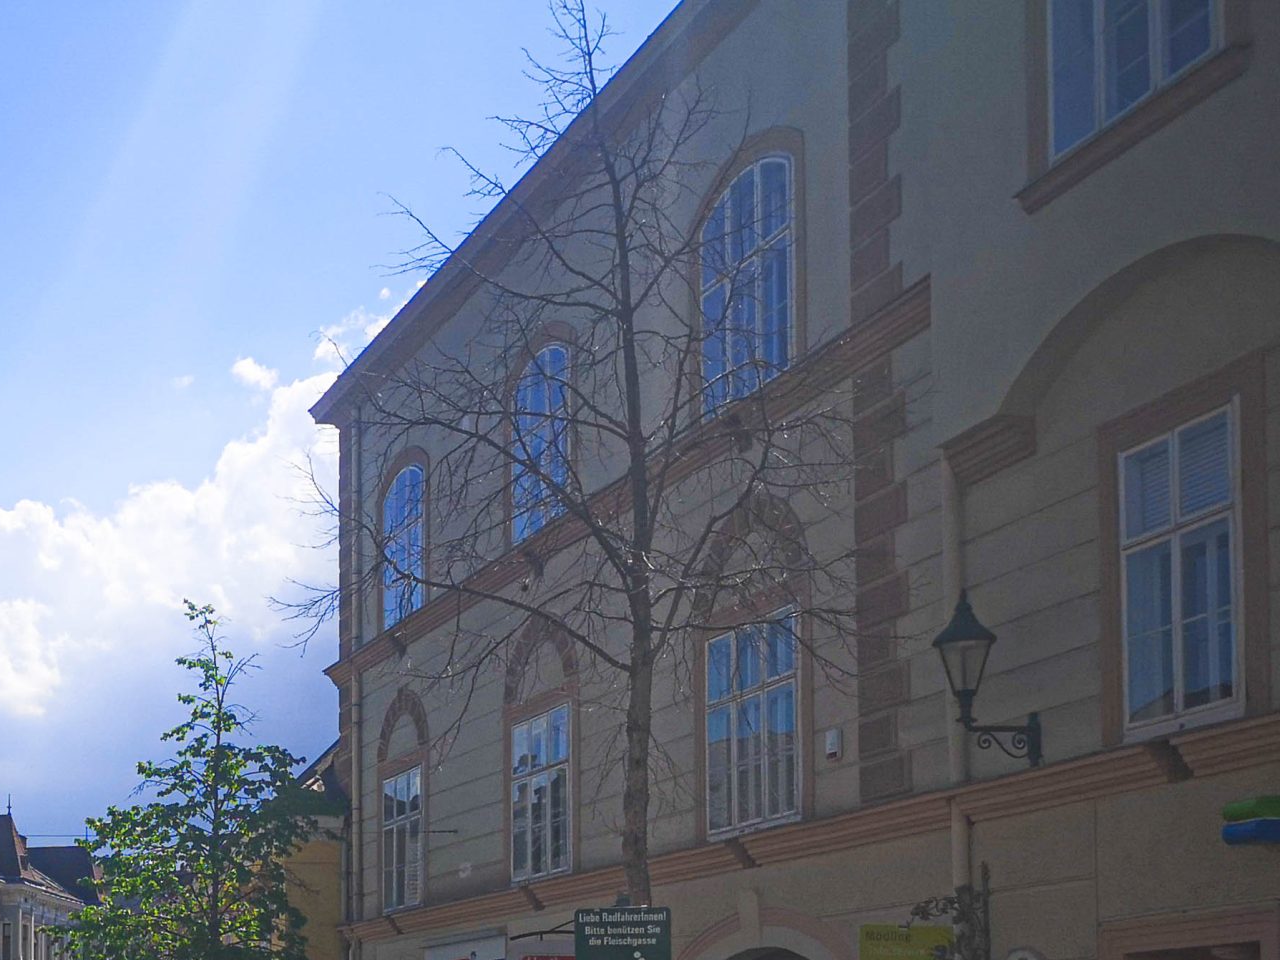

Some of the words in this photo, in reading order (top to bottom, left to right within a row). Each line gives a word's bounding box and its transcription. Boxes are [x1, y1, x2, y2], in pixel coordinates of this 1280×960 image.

[579, 912, 600, 923] Liebe
[602, 911, 666, 922] RadfahrerInnen!
[585, 926, 605, 935] Bitte
[608, 925, 645, 934] benützen
[647, 924, 661, 934] Sie
[589, 937, 601, 945] die
[604, 936, 656, 947] Fleischgasse
